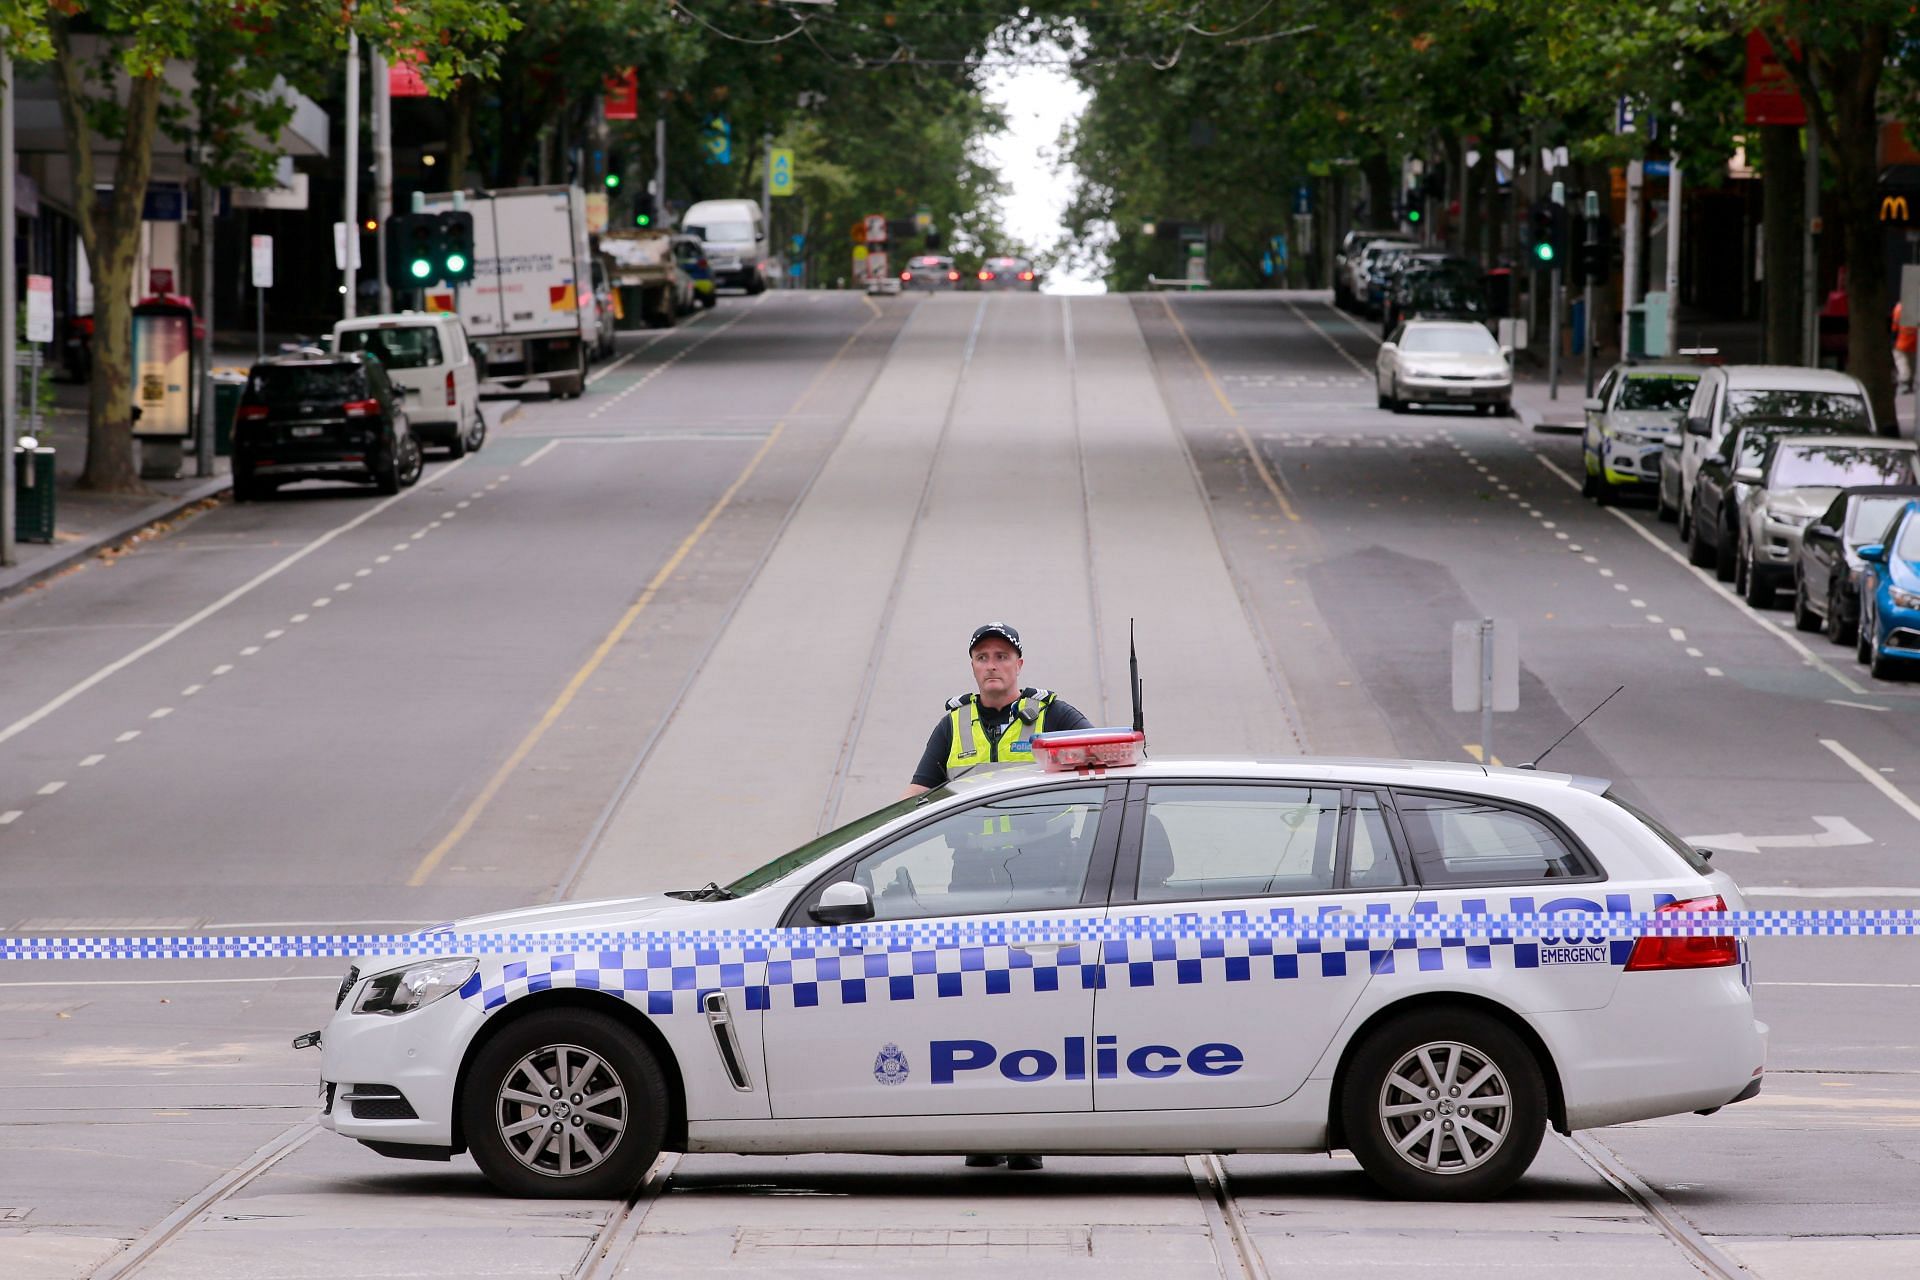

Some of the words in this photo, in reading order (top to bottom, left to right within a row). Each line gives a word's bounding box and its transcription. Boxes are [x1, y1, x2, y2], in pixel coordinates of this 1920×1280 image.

[1011, 742, 1032, 752] Polic
[1541, 947, 1606, 963] EMERGENCY
[930, 1035, 1244, 1084] Police
